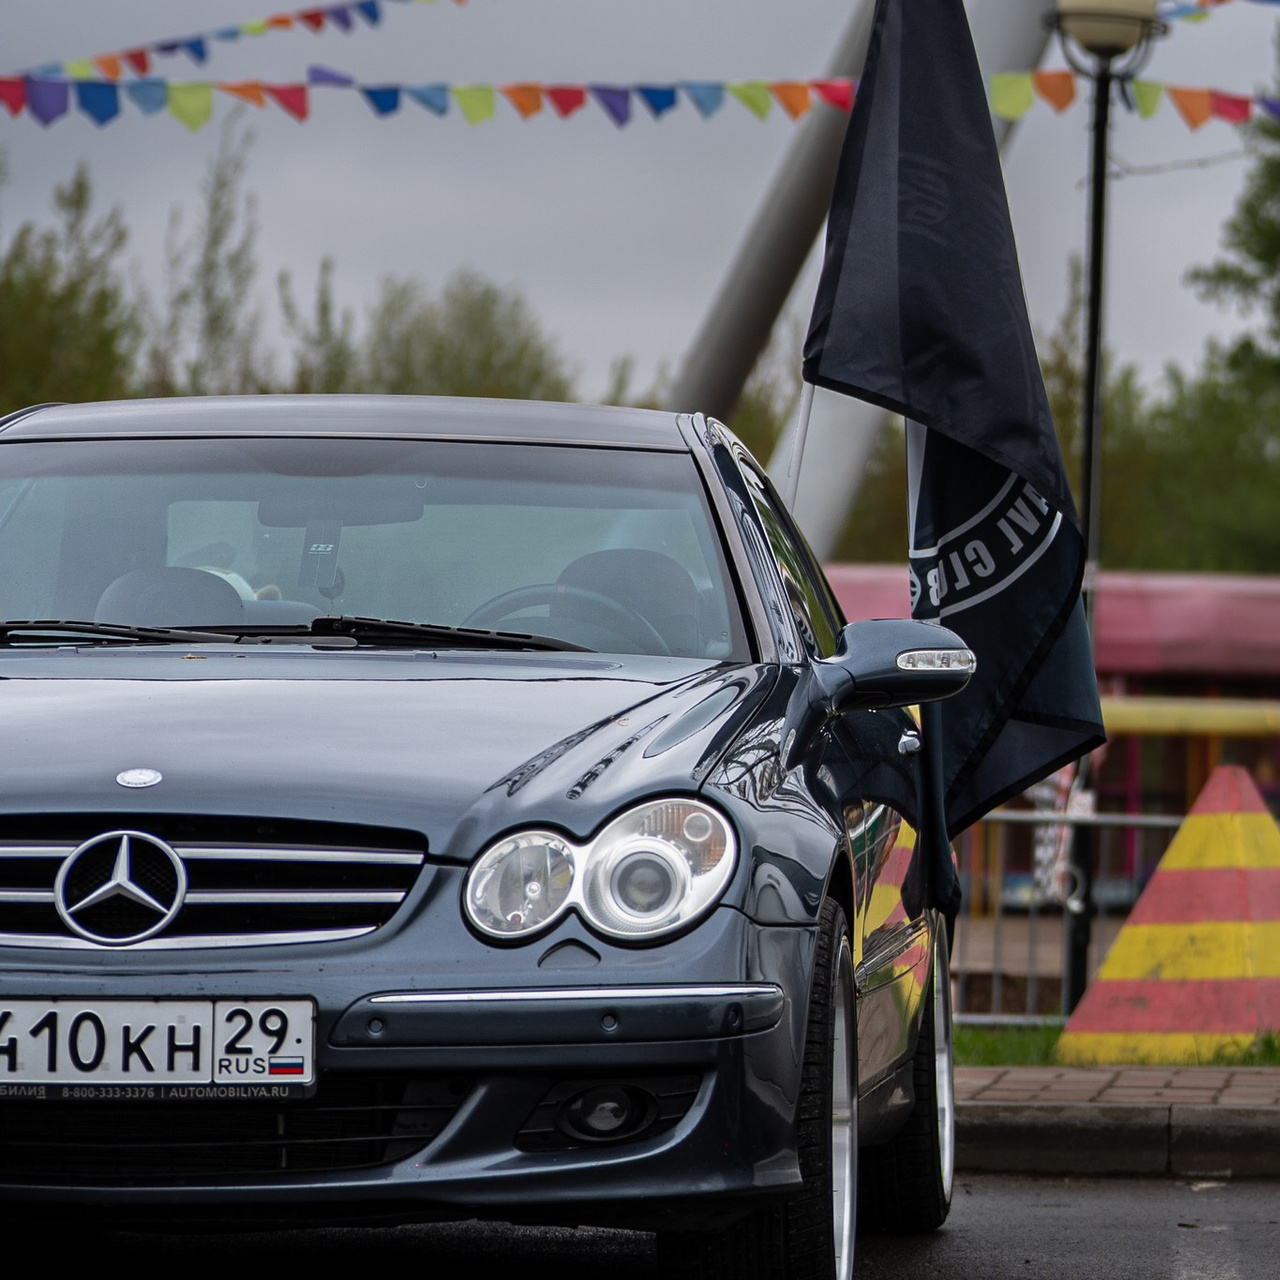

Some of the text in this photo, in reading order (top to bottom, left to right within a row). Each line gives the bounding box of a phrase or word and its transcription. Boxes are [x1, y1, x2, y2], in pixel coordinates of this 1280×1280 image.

[224, 1007, 289, 1055] 29
[218, 1057, 267, 1075] RUS
[61, 1086, 290, 1099] 8-800-333-3376 AUTOMOBILIYA.RU
